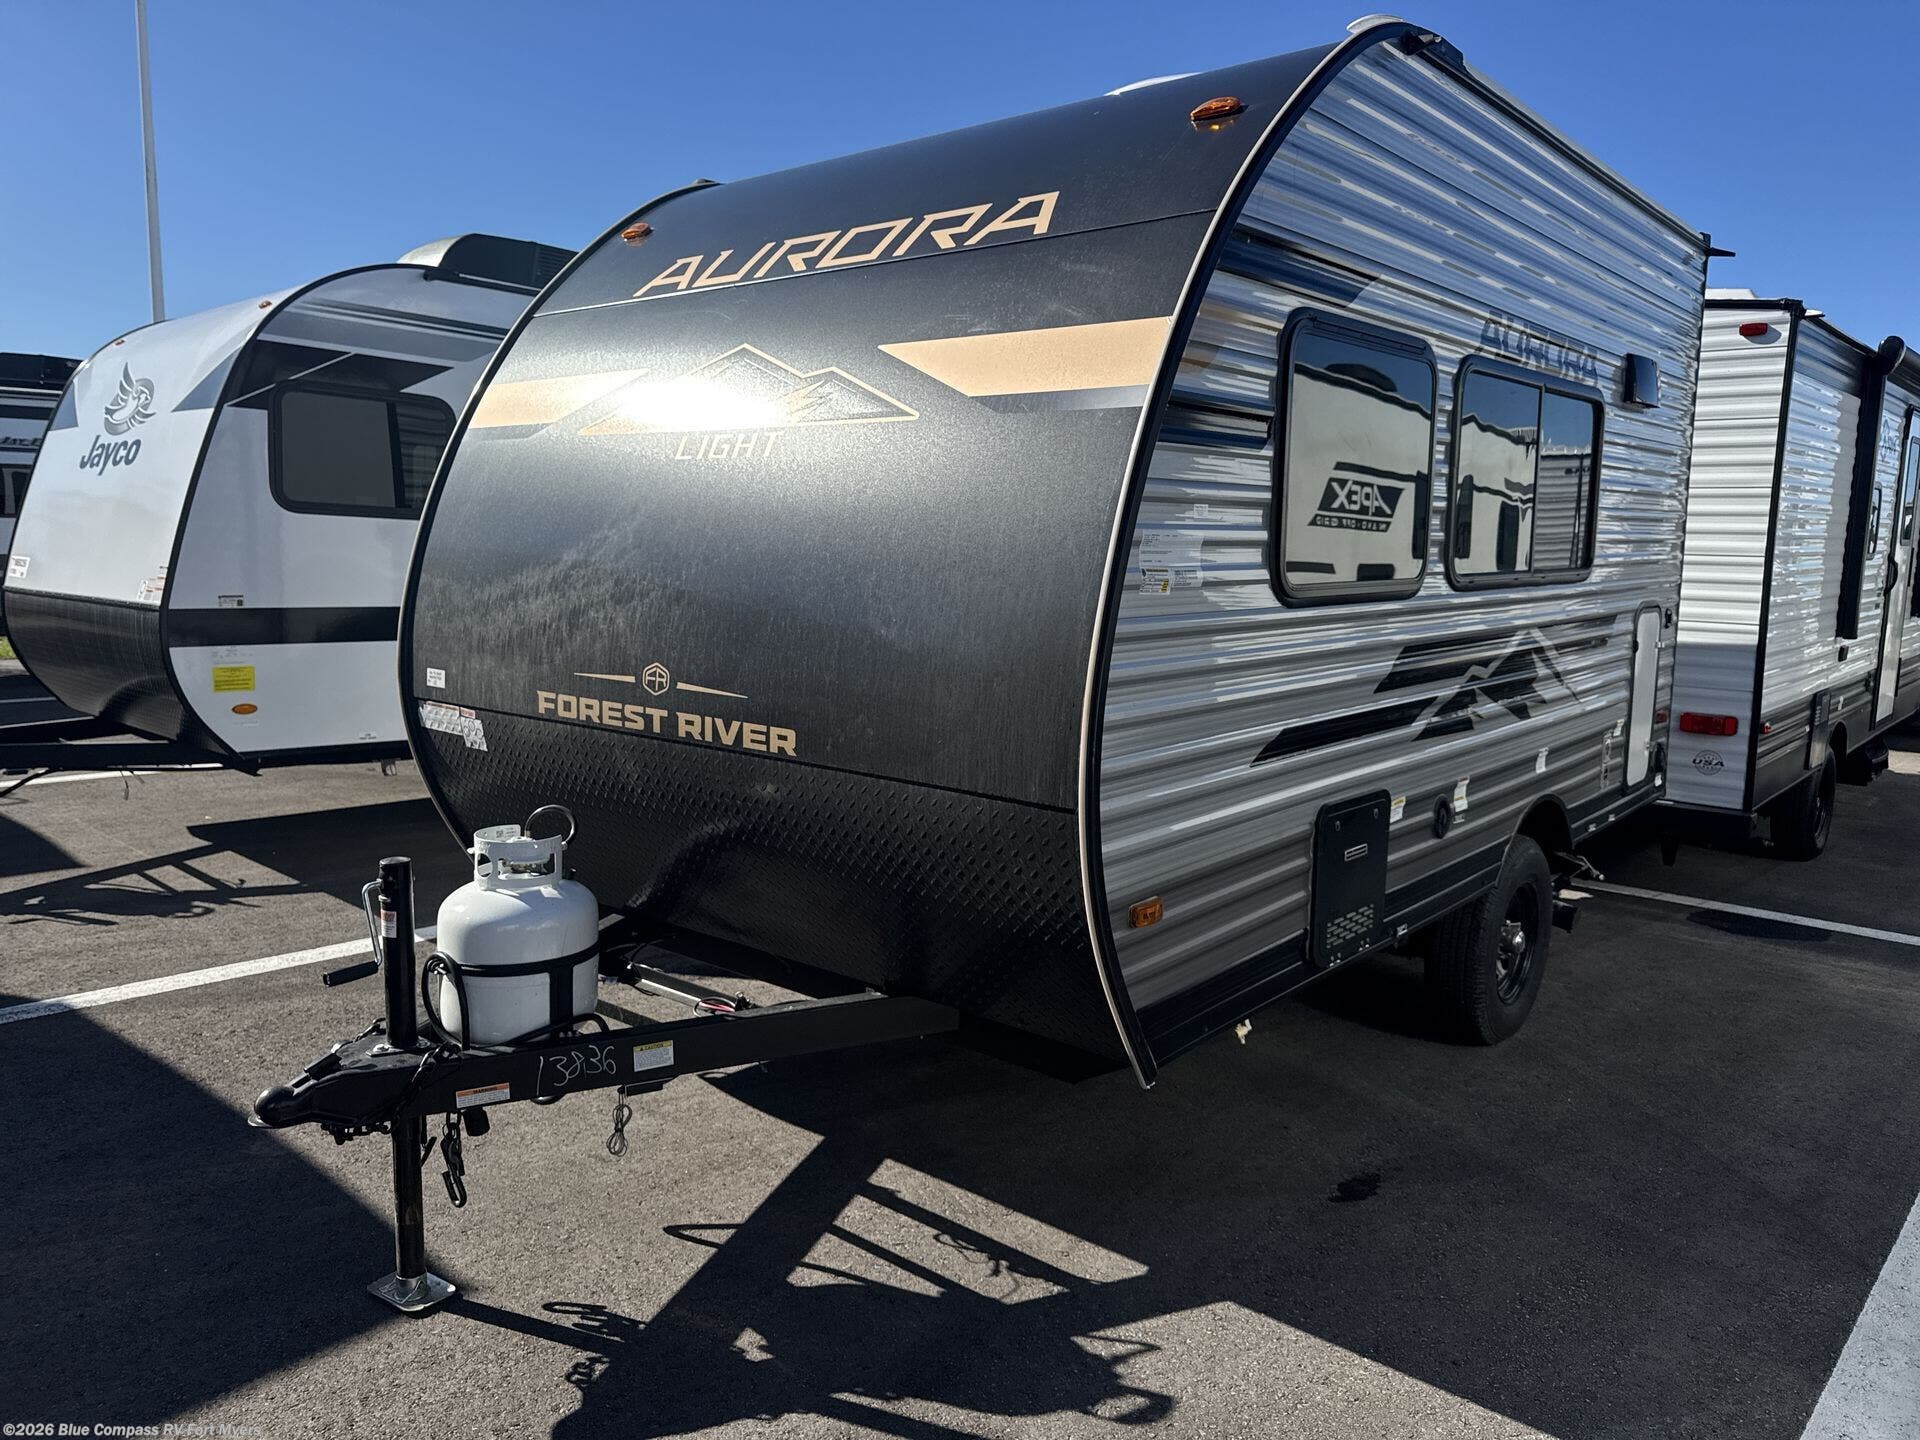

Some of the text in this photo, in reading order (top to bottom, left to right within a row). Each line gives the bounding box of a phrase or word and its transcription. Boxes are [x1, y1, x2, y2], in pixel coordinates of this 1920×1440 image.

[633, 191, 1060, 298] AURORA
[1480, 309, 1599, 388] AURORA
[79, 434, 142, 476] Jayco
[674, 430, 785, 460] LIGHT
[536, 690, 669, 735] FOREST
[675, 711, 797, 757] RIVER
